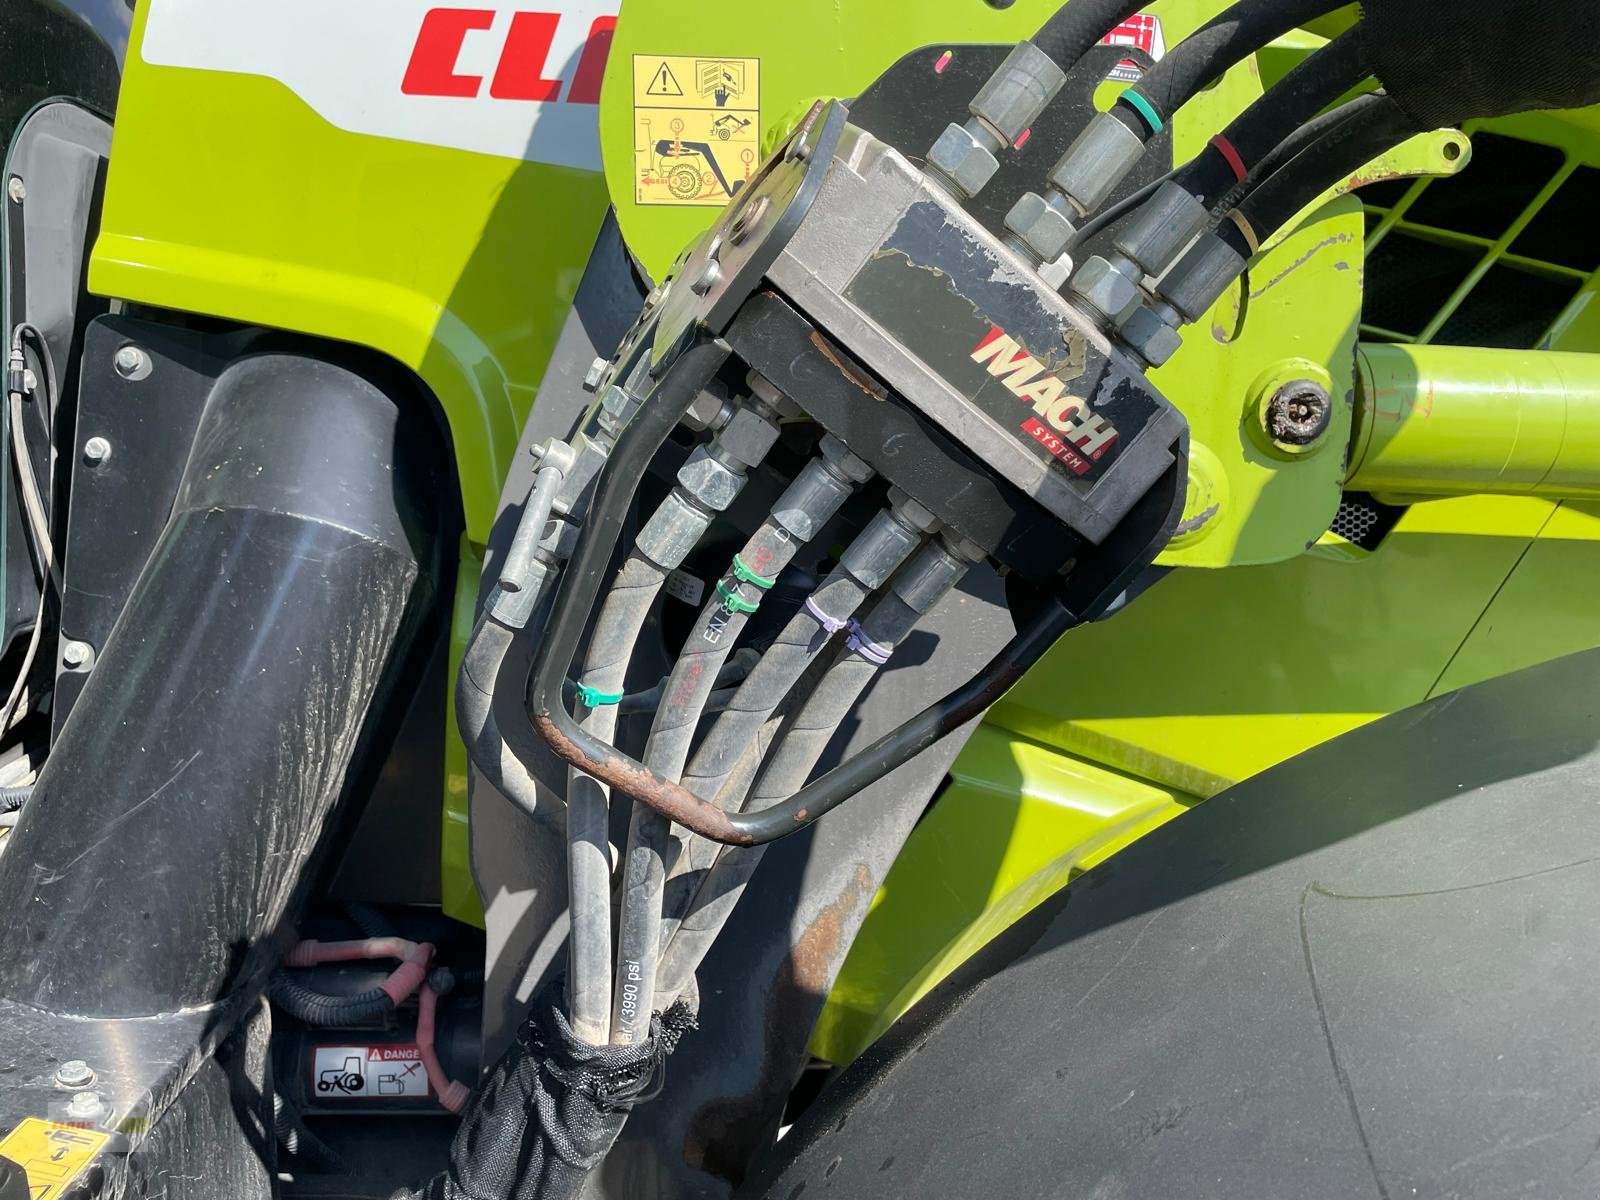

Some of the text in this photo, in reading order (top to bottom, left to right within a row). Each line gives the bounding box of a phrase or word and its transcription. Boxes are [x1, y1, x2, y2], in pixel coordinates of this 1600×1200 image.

[970, 334, 1119, 456] MACH
[1032, 426, 1082, 468] SYSTEM
[703, 616, 728, 644] EN
[625, 959, 643, 981] psi
[621, 984, 638, 1017] 3990
[384, 1049, 420, 1060] DANGE
